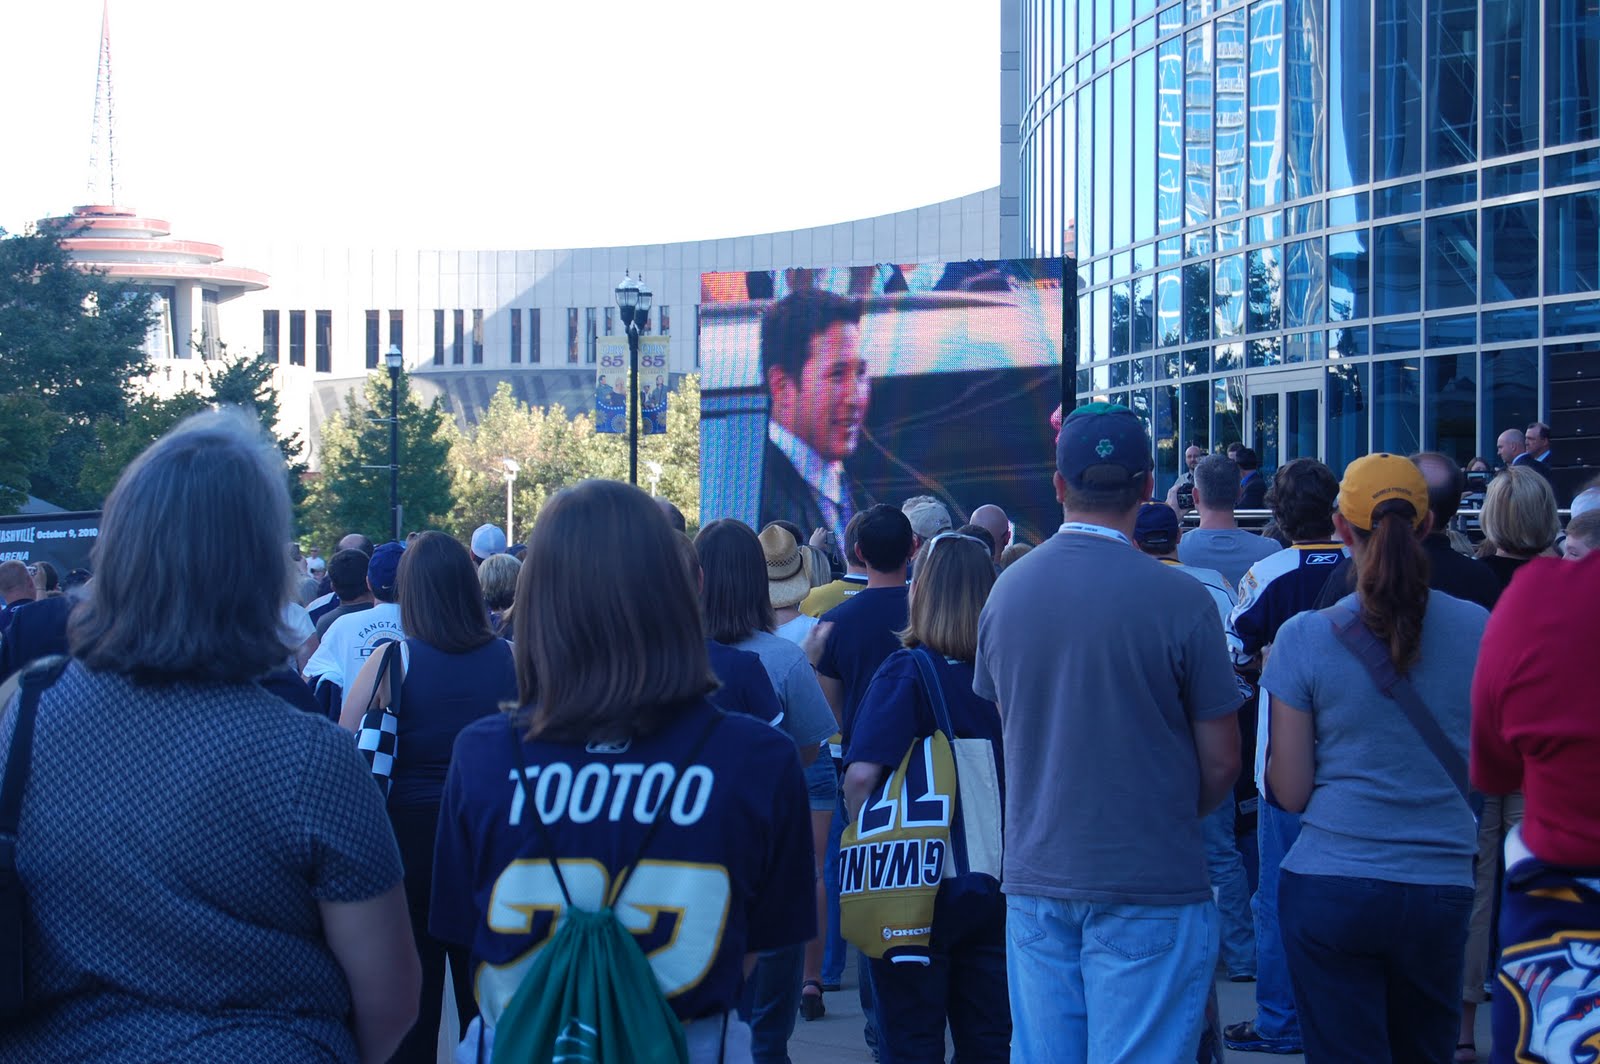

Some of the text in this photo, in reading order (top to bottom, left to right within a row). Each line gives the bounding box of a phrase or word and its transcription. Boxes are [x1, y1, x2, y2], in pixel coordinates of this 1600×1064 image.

[600, 355, 624, 368] 85
[641, 355, 666, 368] 85
[0, 527, 98, 543] ASHVILLE October 9, 2010
[0, 551, 30, 561] ARENA
[508, 762, 715, 826] TOOTOO
